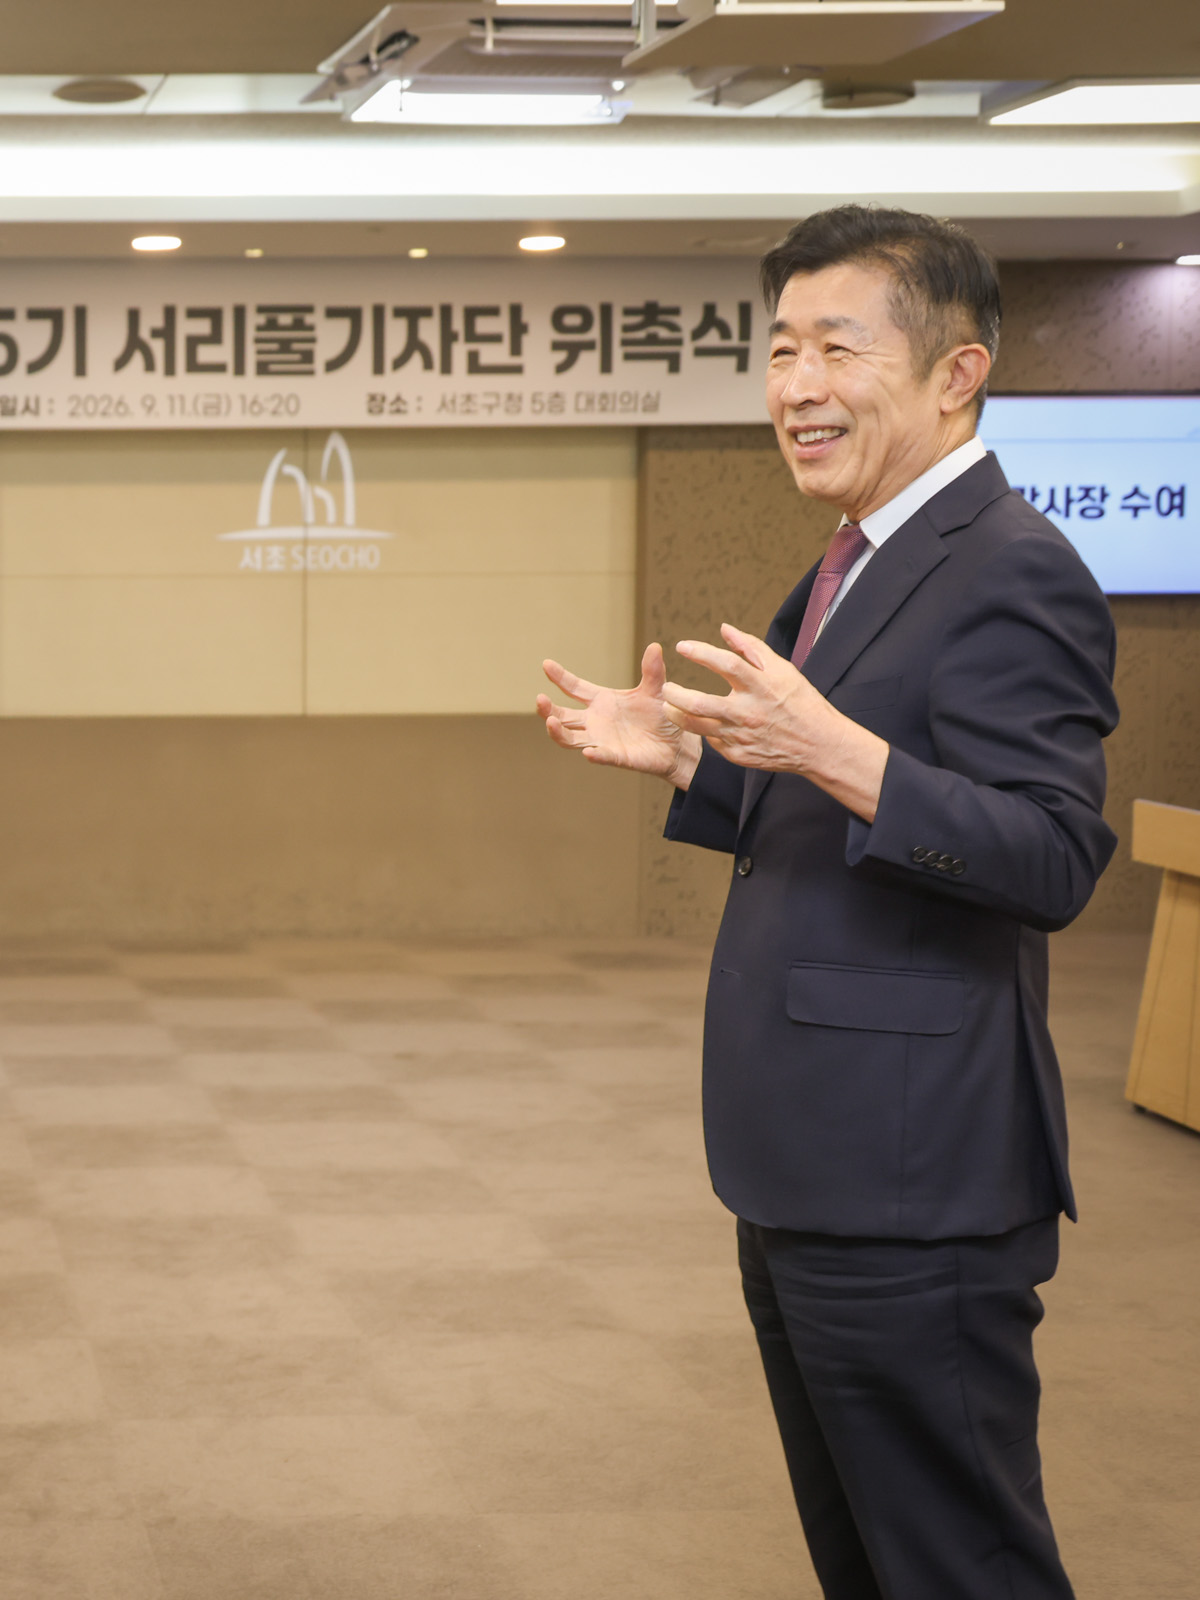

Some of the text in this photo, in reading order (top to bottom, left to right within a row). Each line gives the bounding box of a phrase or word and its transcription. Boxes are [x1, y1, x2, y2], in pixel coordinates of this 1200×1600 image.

[113, 303, 529, 377] 서리풀기자단
[550, 301, 752, 375] 위촉식
[240, 393, 301, 417] 16:20
[435, 391, 524, 415] 서초구청
[531, 391, 566, 415] 5층
[573, 390, 661, 414] 대회의실
[1120, 484, 1186, 520] 수여
[239, 544, 381, 572] 서초 SEOCHO
